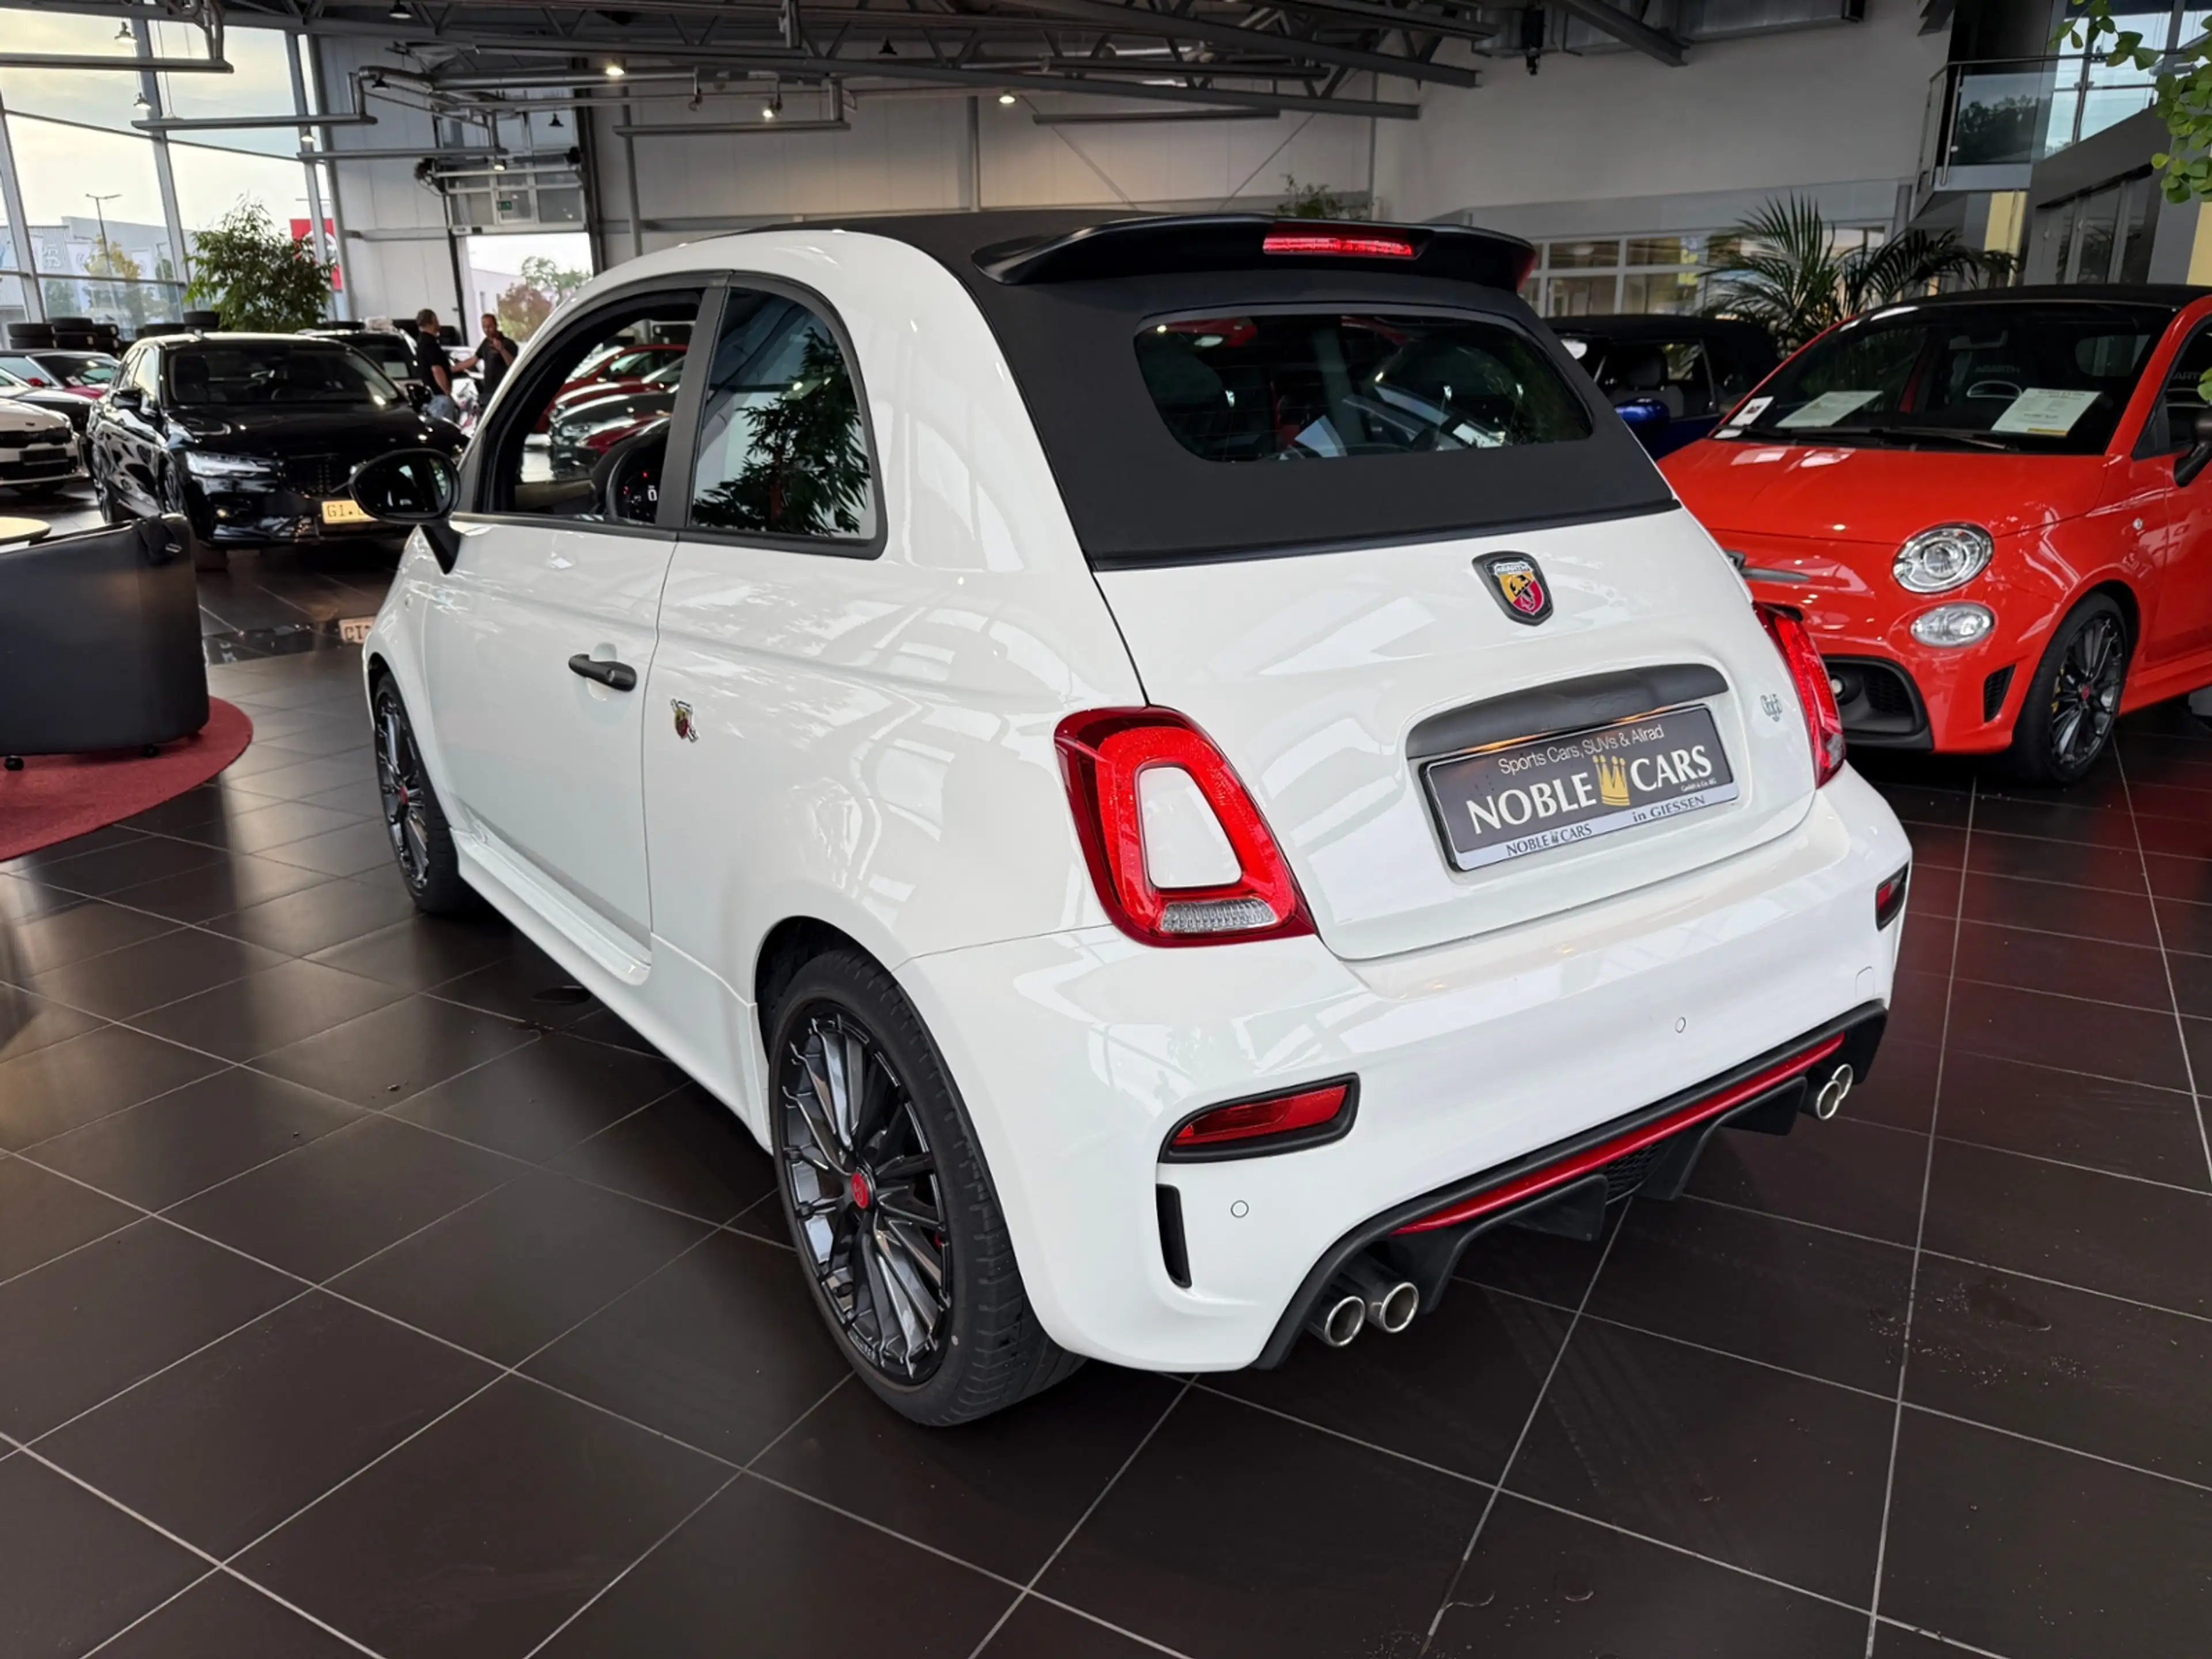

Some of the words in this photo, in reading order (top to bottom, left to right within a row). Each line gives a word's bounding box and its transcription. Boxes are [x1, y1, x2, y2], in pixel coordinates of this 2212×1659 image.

[1499, 752, 1547, 775] Sports
[1547, 745, 1584, 762] Cars,
[1582, 737, 1618, 754] SUVs
[1619, 733, 1631, 746] &
[1632, 724, 1664, 744] Allrad
[1466, 772, 1597, 835] NOBLE
[1630, 745, 1712, 791] CARS
[1632, 812, 1646, 822] in
[1650, 795, 1705, 817] GIESSEN
[1506, 835, 1550, 856] NOBLE
[1560, 823, 1592, 842] CARS
